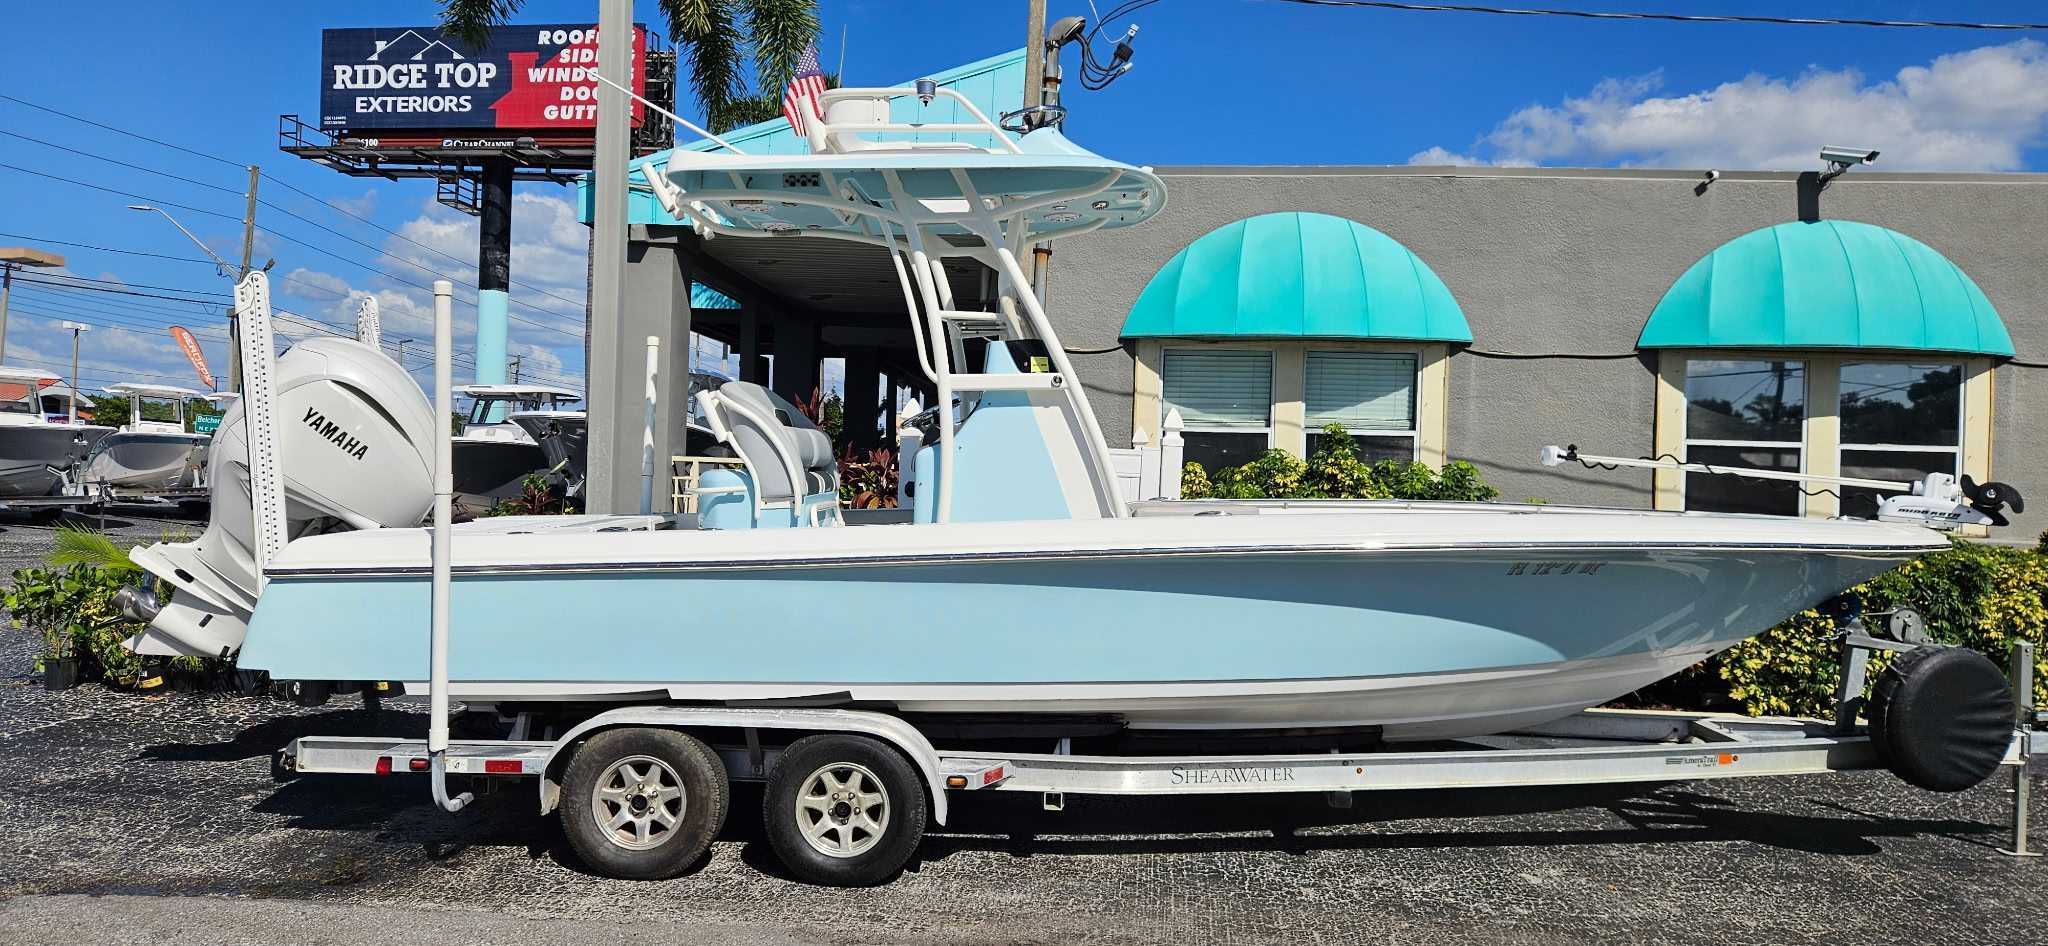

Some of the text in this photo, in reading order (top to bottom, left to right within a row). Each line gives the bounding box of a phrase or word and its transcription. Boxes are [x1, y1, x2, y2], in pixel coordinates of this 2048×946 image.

[537, 29, 636, 45] ROOF
[559, 48, 636, 63] SID
[333, 62, 497, 89] RIDGE TOP
[527, 66, 635, 83] WINDO
[560, 85, 634, 101] DOO
[355, 95, 472, 113] EXTERIORS
[543, 104, 634, 120] GUTT
[302, 406, 369, 461] YAMAHA
